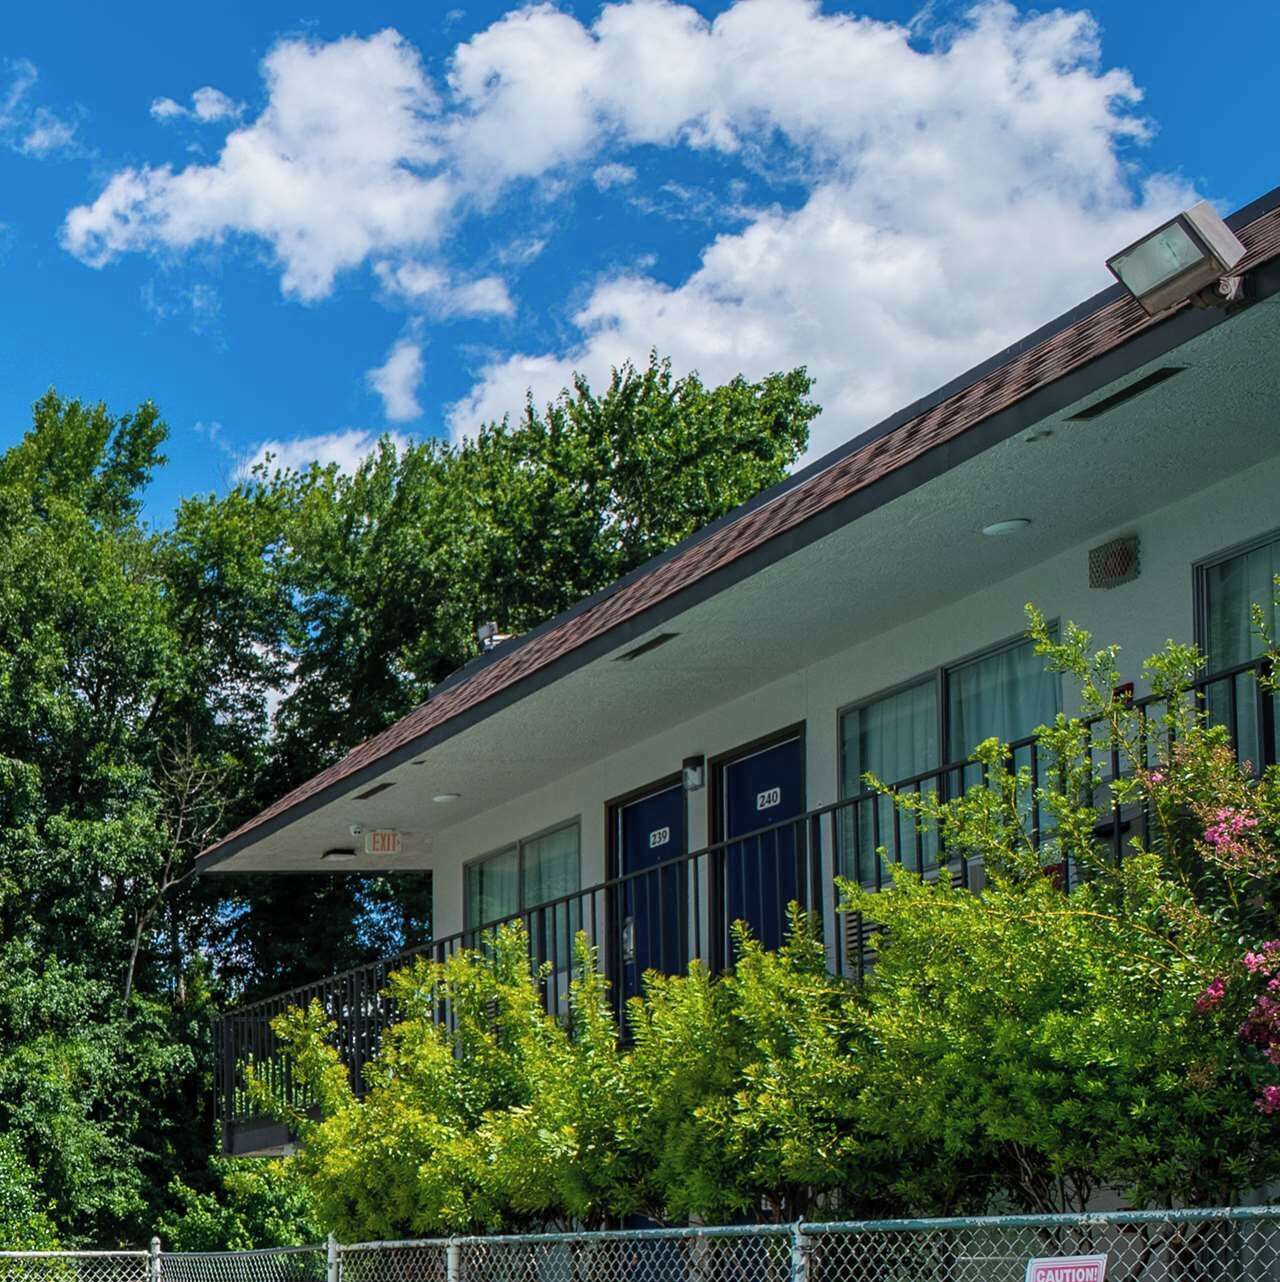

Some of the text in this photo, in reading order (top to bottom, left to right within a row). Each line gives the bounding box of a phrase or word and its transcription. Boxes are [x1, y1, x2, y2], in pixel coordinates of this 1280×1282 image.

[758, 790, 779, 808] 240
[372, 832, 397, 852] EXIT
[650, 829, 668, 846] 239
